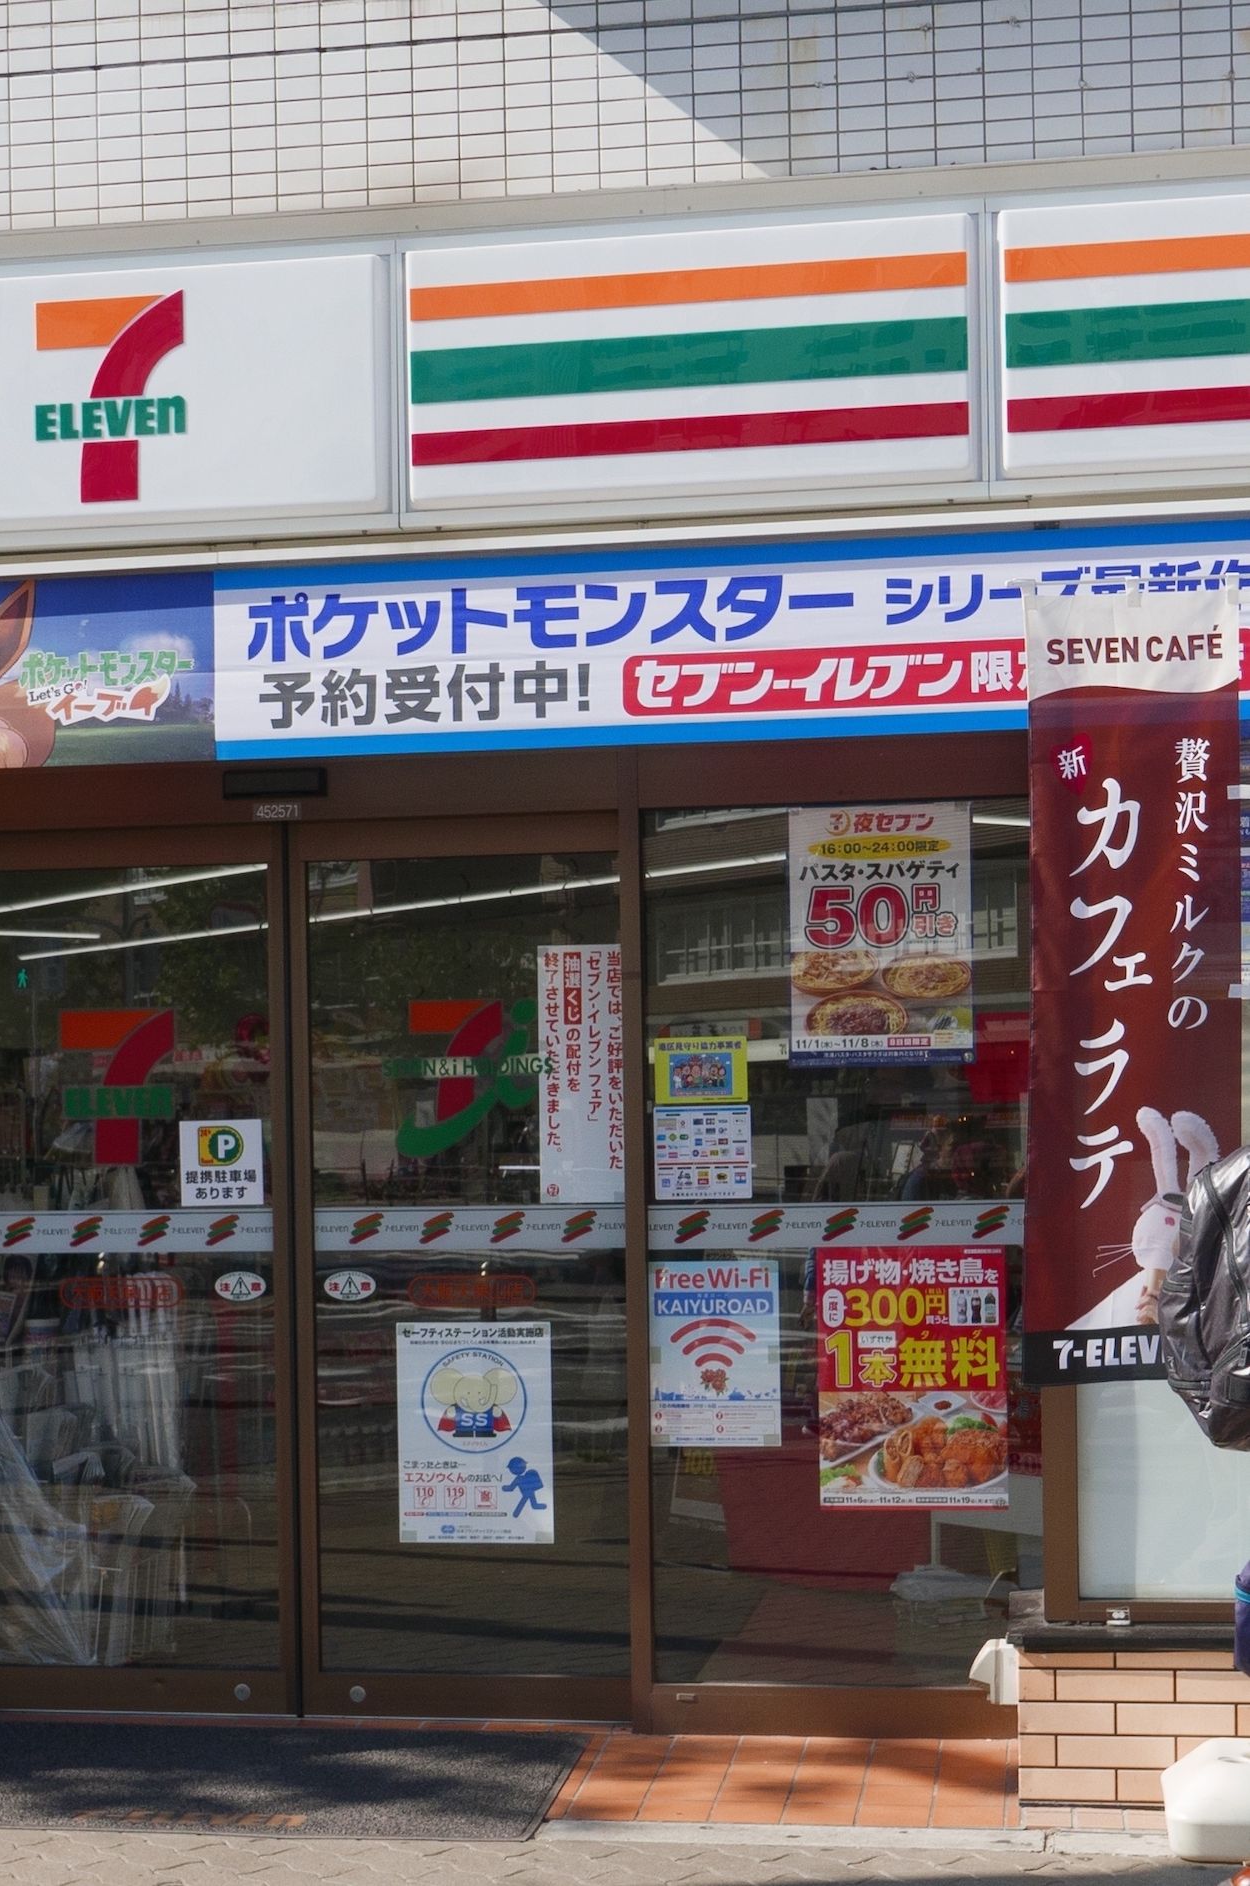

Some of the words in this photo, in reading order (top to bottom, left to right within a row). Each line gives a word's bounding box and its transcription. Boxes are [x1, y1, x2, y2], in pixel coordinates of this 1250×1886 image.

[248, 575, 854, 662] ポケットモンスター
[1047, 636, 1139, 665] SEVEN
[1146, 625, 1223, 662] CAFÉ
[19, 651, 194, 688] ポケットモンスター
[29, 686, 61, 702] Let's
[1057, 746, 1087, 780] 新
[256, 804, 299, 818] 452571
[854, 812, 934, 833] 夜セブン
[799, 860, 960, 882] パスタ・スパゲティ
[1167, 737, 1211, 1030] 贅沢ミルクの
[1069, 777, 1153, 1210] カフェラテ
[218, 1134, 236, 1159] P
[186, 1169, 257, 1184] 提携駐車場
[196, 1186, 247, 1199] あります
[655, 1268, 705, 1289] Free
[707, 1267, 770, 1289] Wi-Fi
[823, 1258, 999, 1286] 揚げ物・焼き鳥を
[657, 1299, 770, 1315] KAIYUROAD
[402, 1327, 544, 1339] セーフティステーション活動実施店
[861, 1335, 893, 1344] いずれか
[442, 1351, 470, 1368] SAFETY
[472, 1351, 504, 1367] STATION
[460, 1413, 488, 1427] SS
[416, 1487, 434, 1498] 110
[446, 1487, 464, 1498] 119
